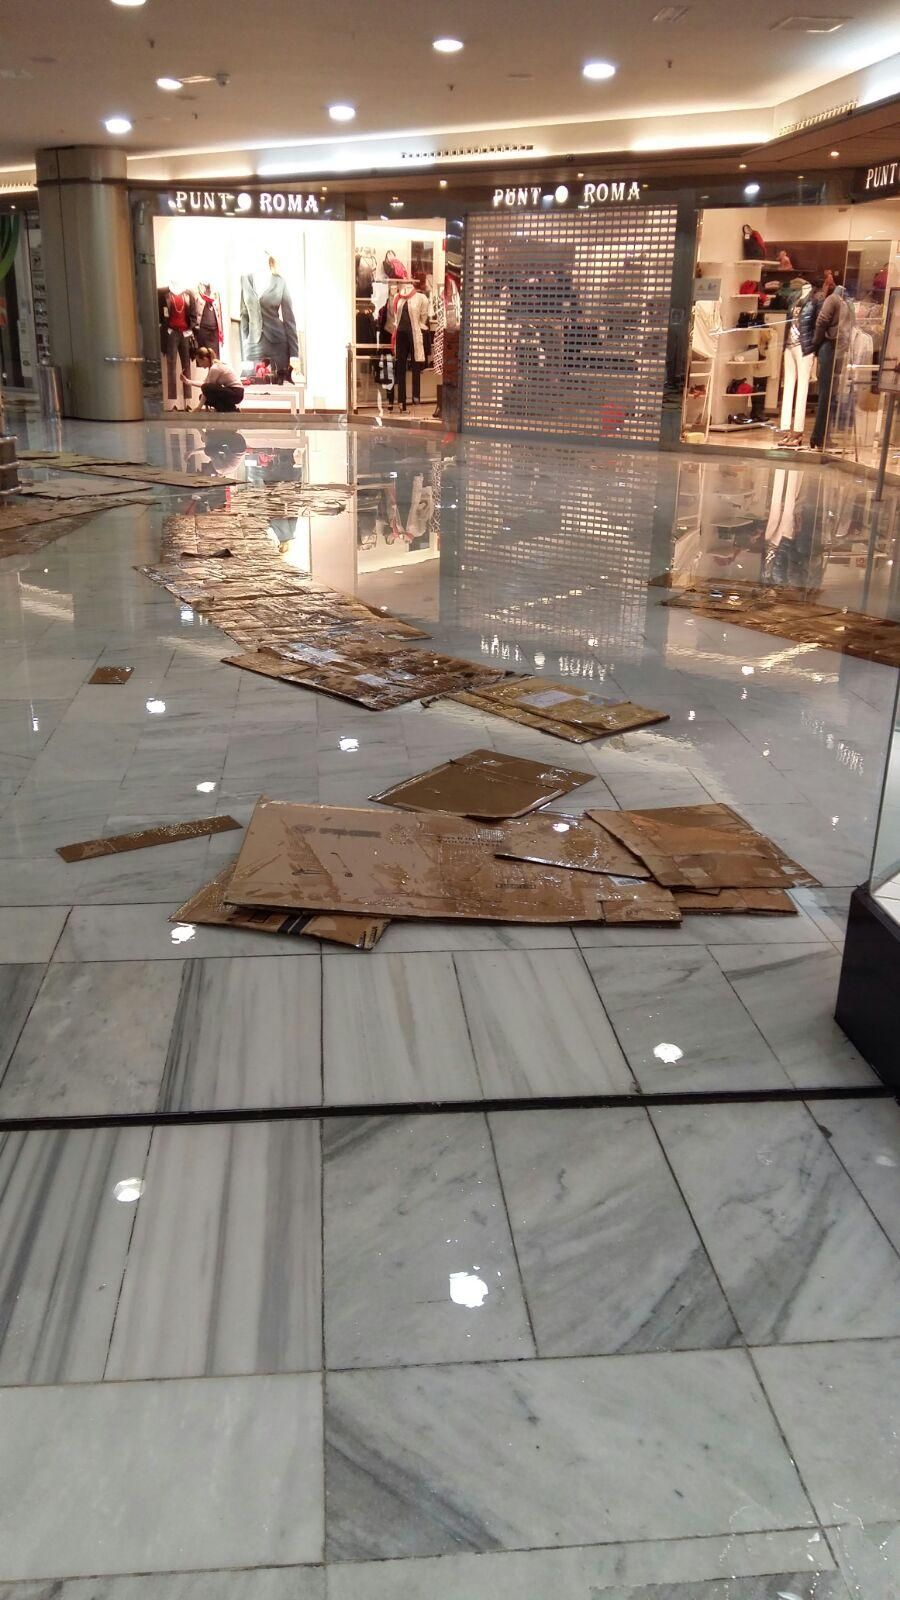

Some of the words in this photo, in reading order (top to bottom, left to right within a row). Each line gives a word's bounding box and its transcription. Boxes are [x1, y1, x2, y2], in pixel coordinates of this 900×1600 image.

[865, 162, 900, 190] PUNT
[259, 192, 319, 213] ROMA
[584, 181, 640, 204] ROMA
